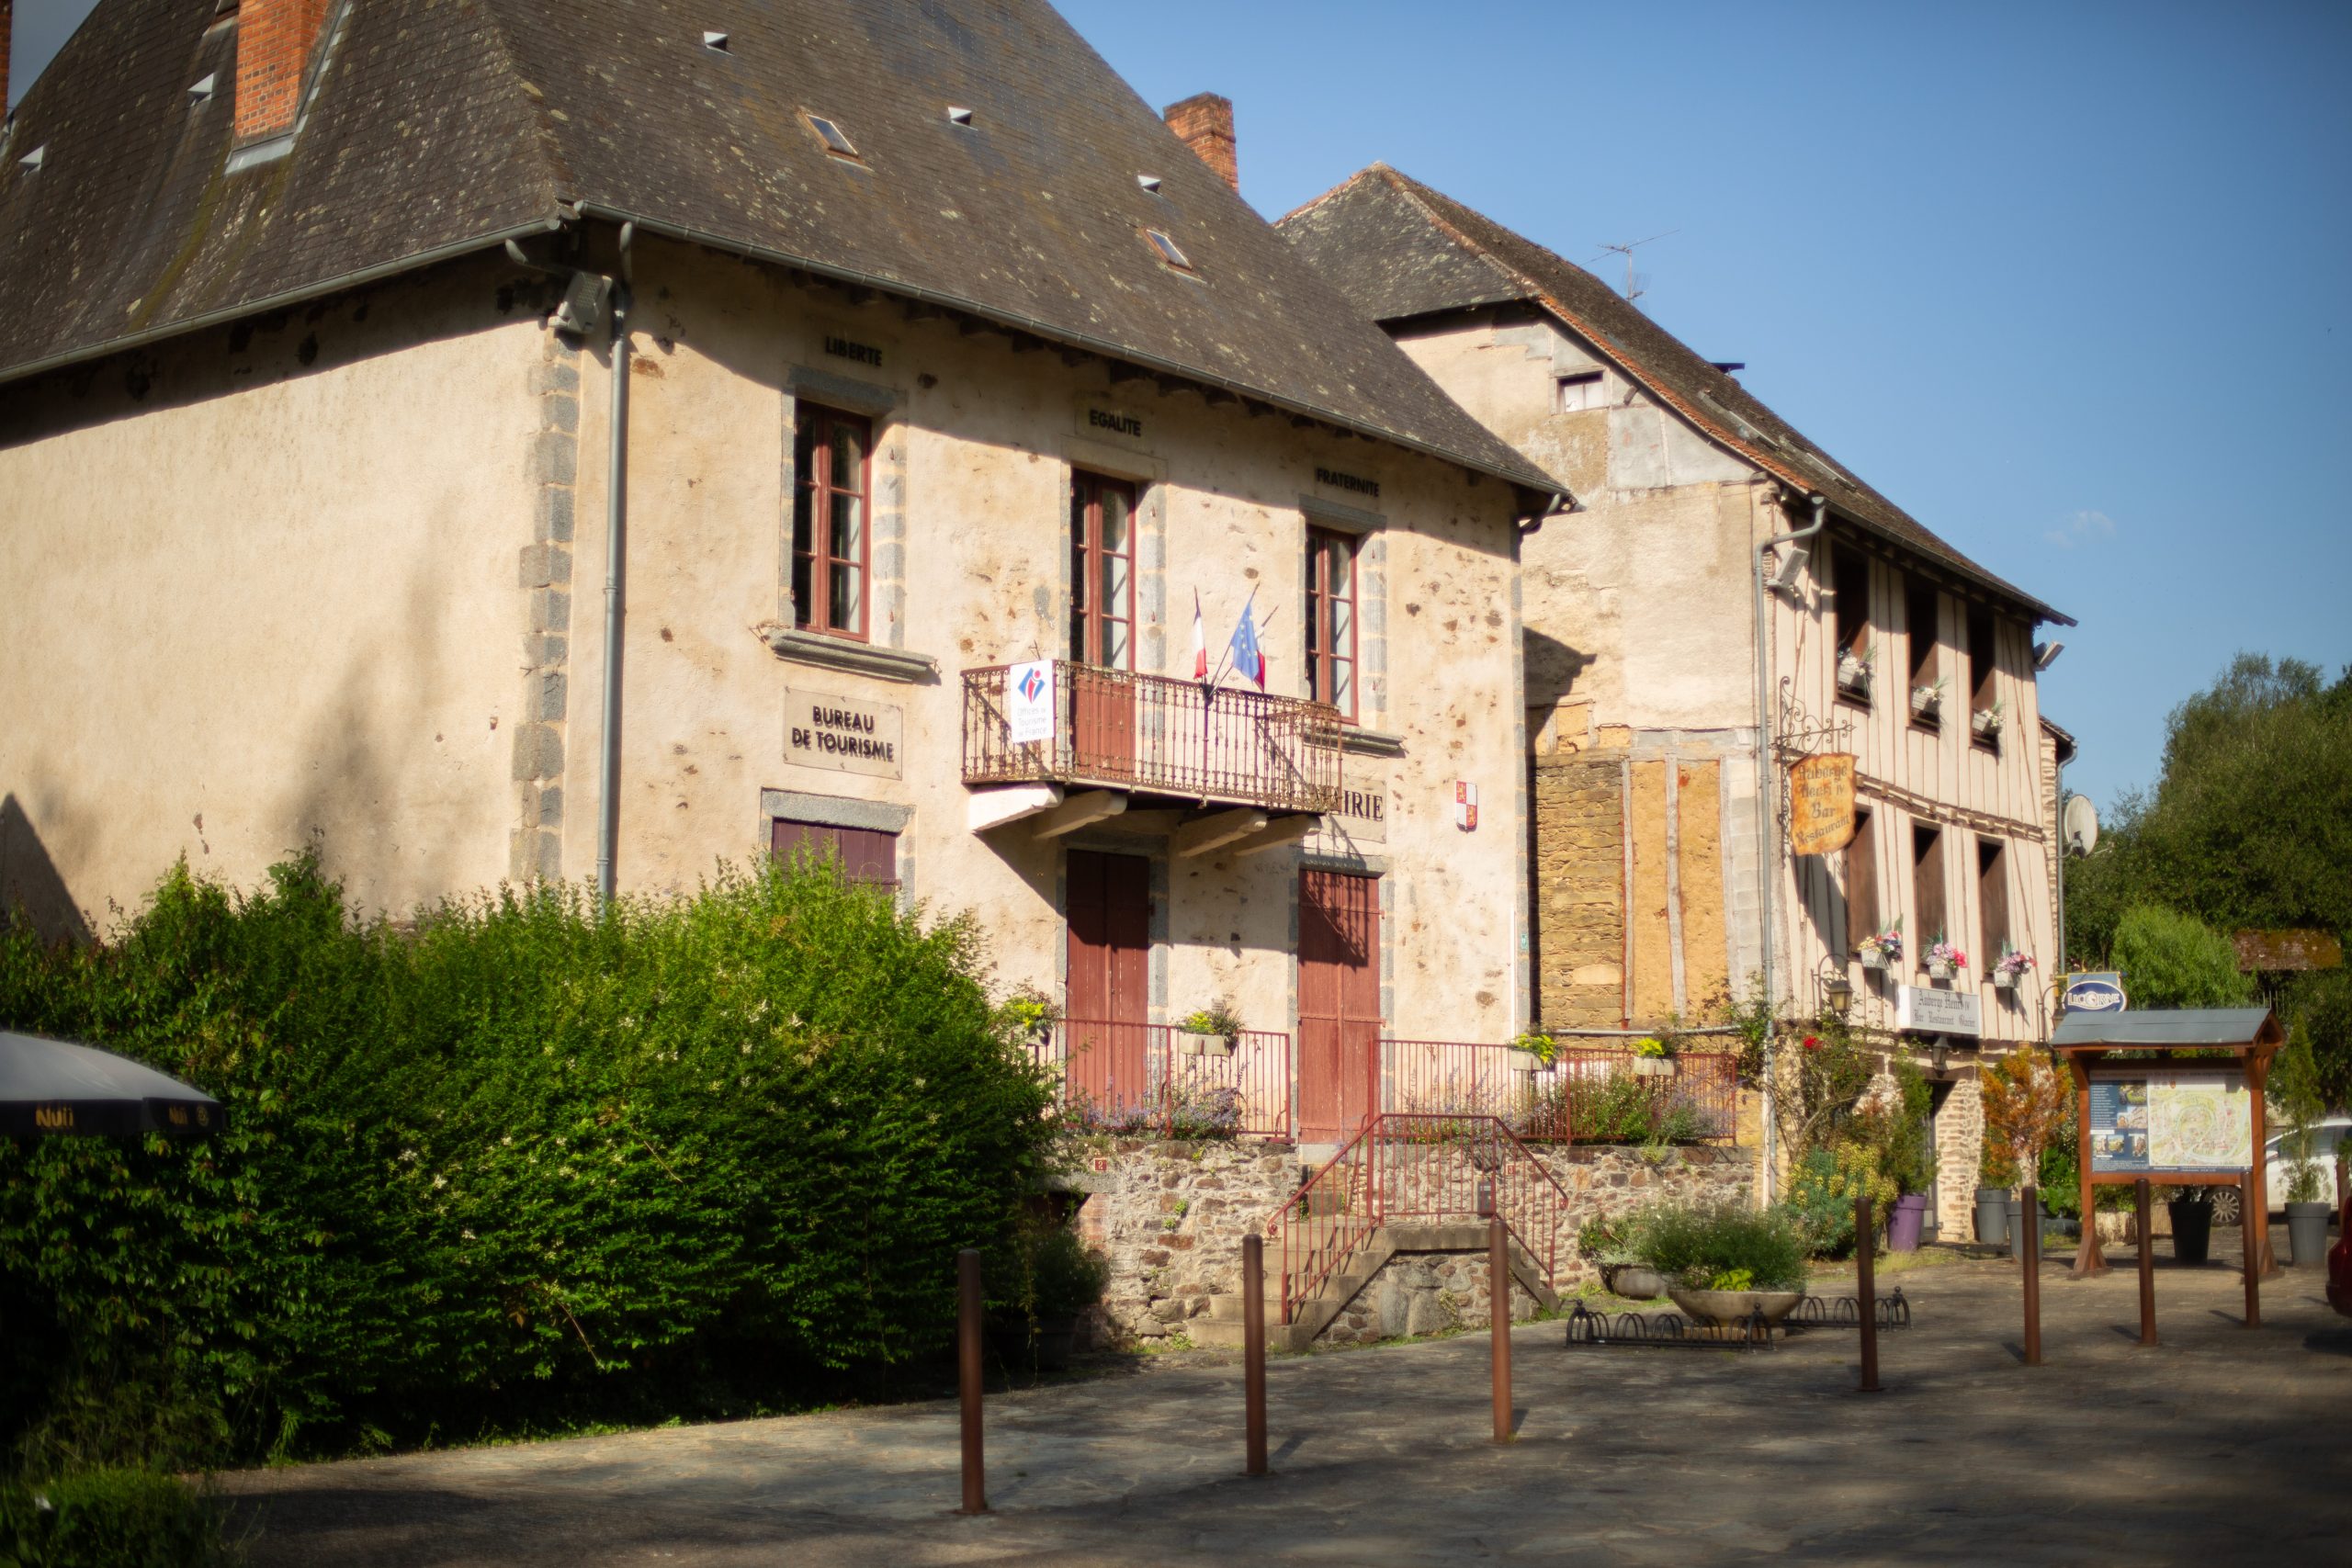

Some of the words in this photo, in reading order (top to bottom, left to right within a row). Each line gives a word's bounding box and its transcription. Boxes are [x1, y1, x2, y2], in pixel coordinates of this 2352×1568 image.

[812, 705, 874, 734] BUREAU
[792, 728, 811, 750] DE
[816, 731, 894, 762] TOURISME
[1798, 762, 1848, 783] Auberge
[1812, 801, 1836, 819] Bar
